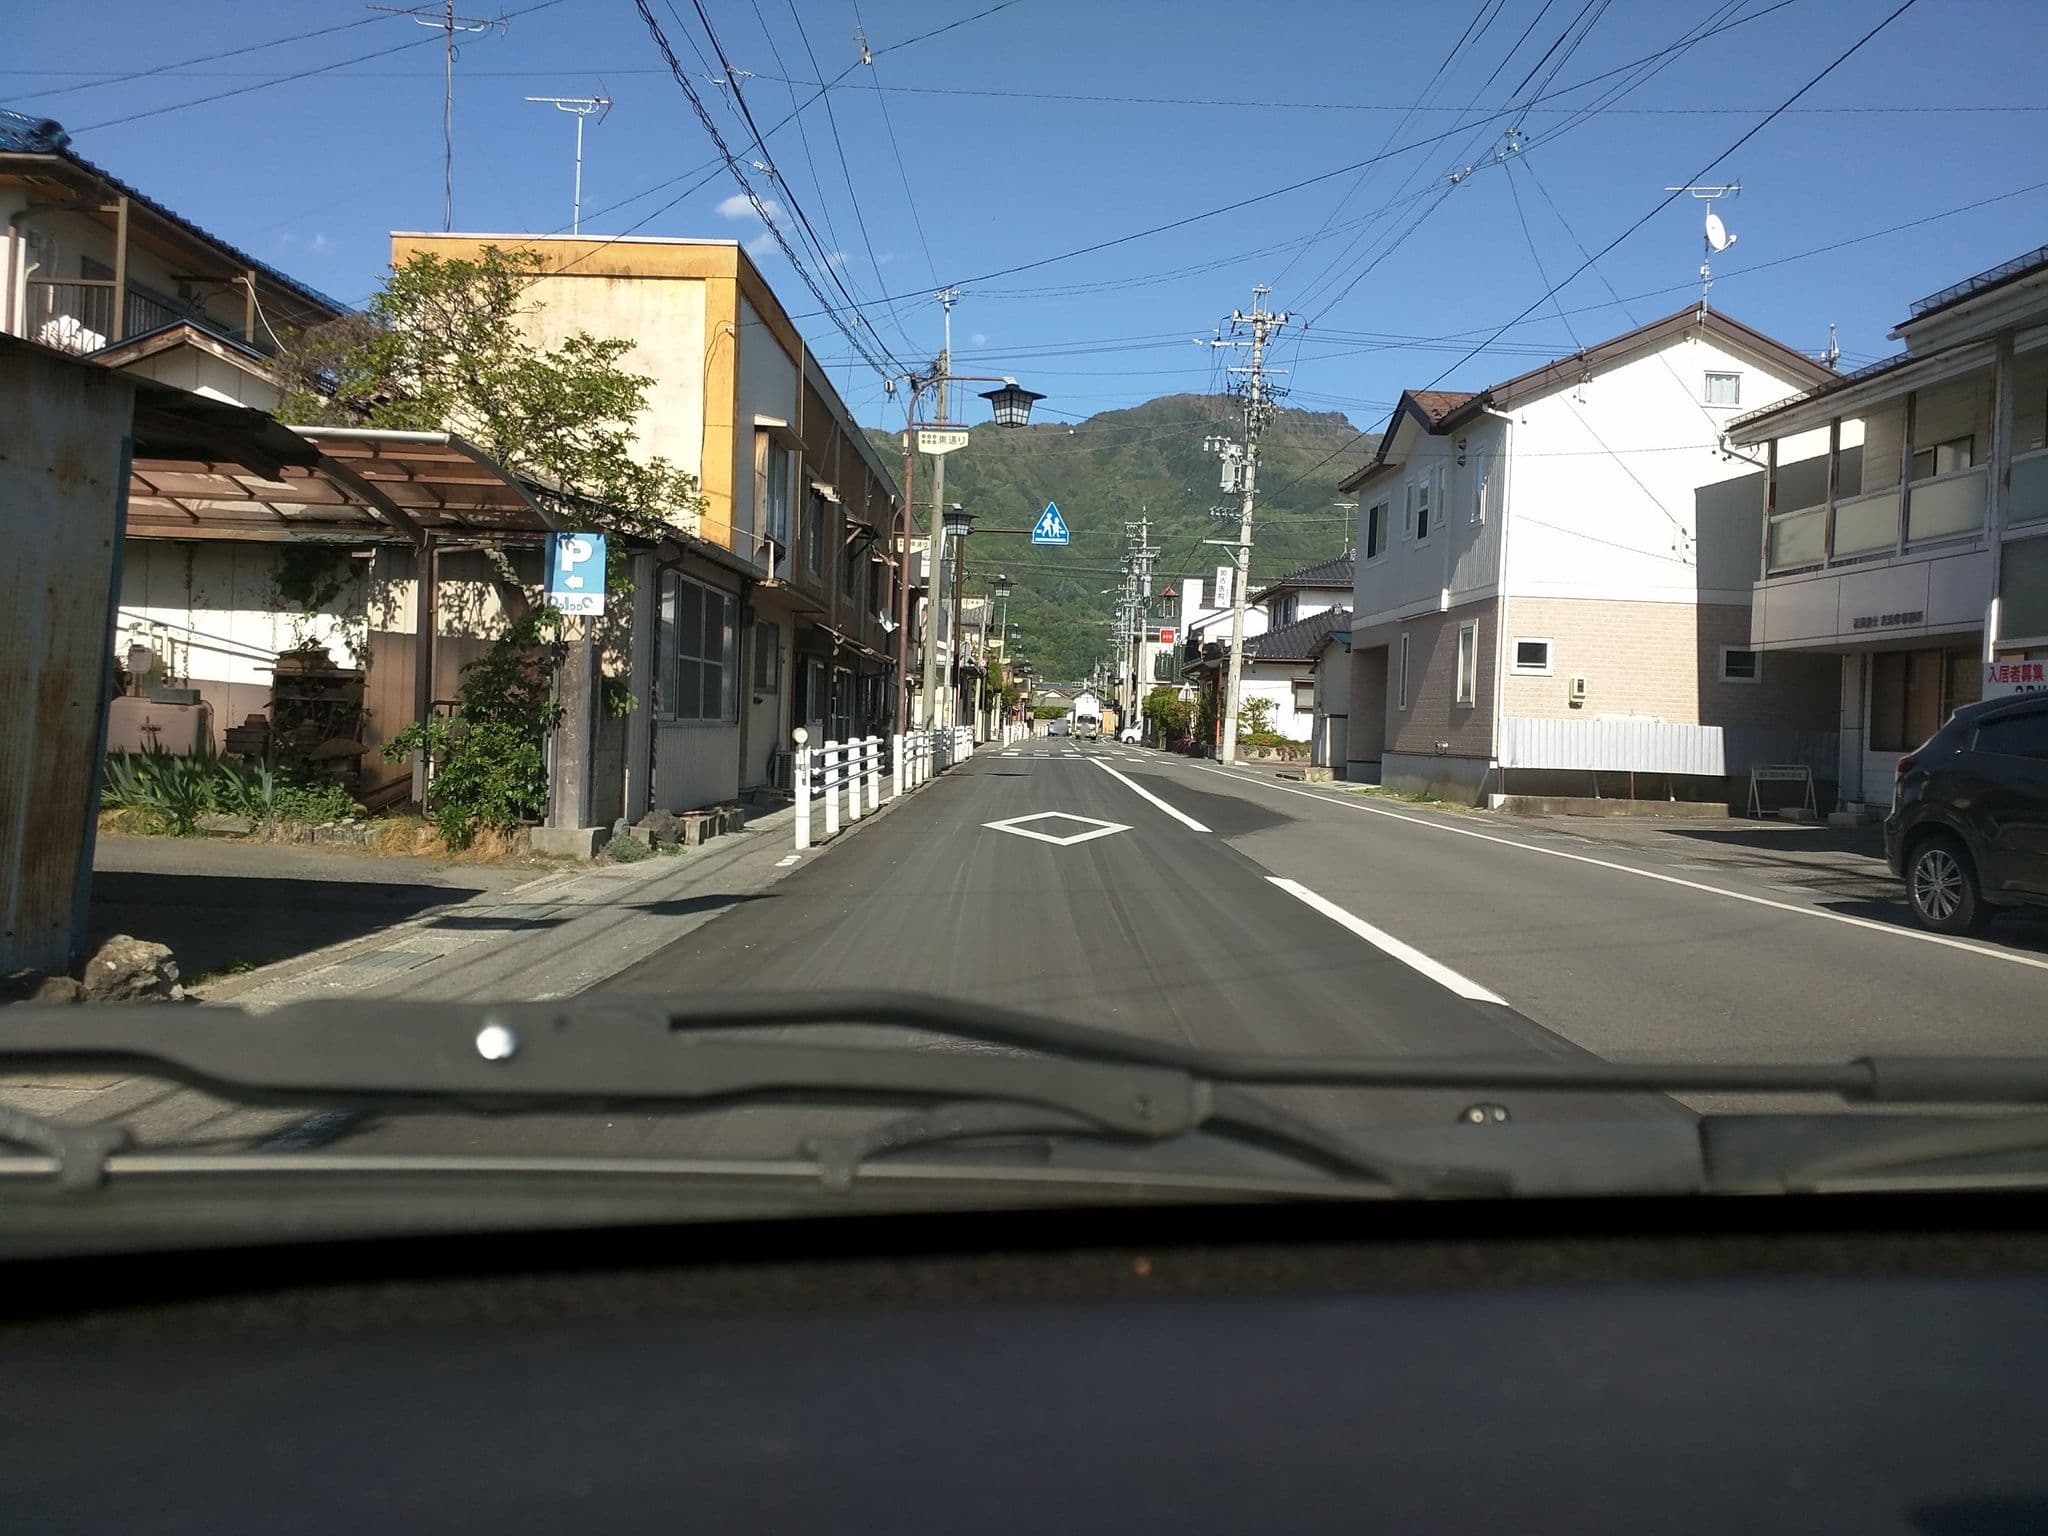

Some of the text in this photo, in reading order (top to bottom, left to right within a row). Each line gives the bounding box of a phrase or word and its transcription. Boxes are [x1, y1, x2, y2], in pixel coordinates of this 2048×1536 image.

[561, 538, 593, 572] P
[1988, 664, 2045, 683] 入居者募集
